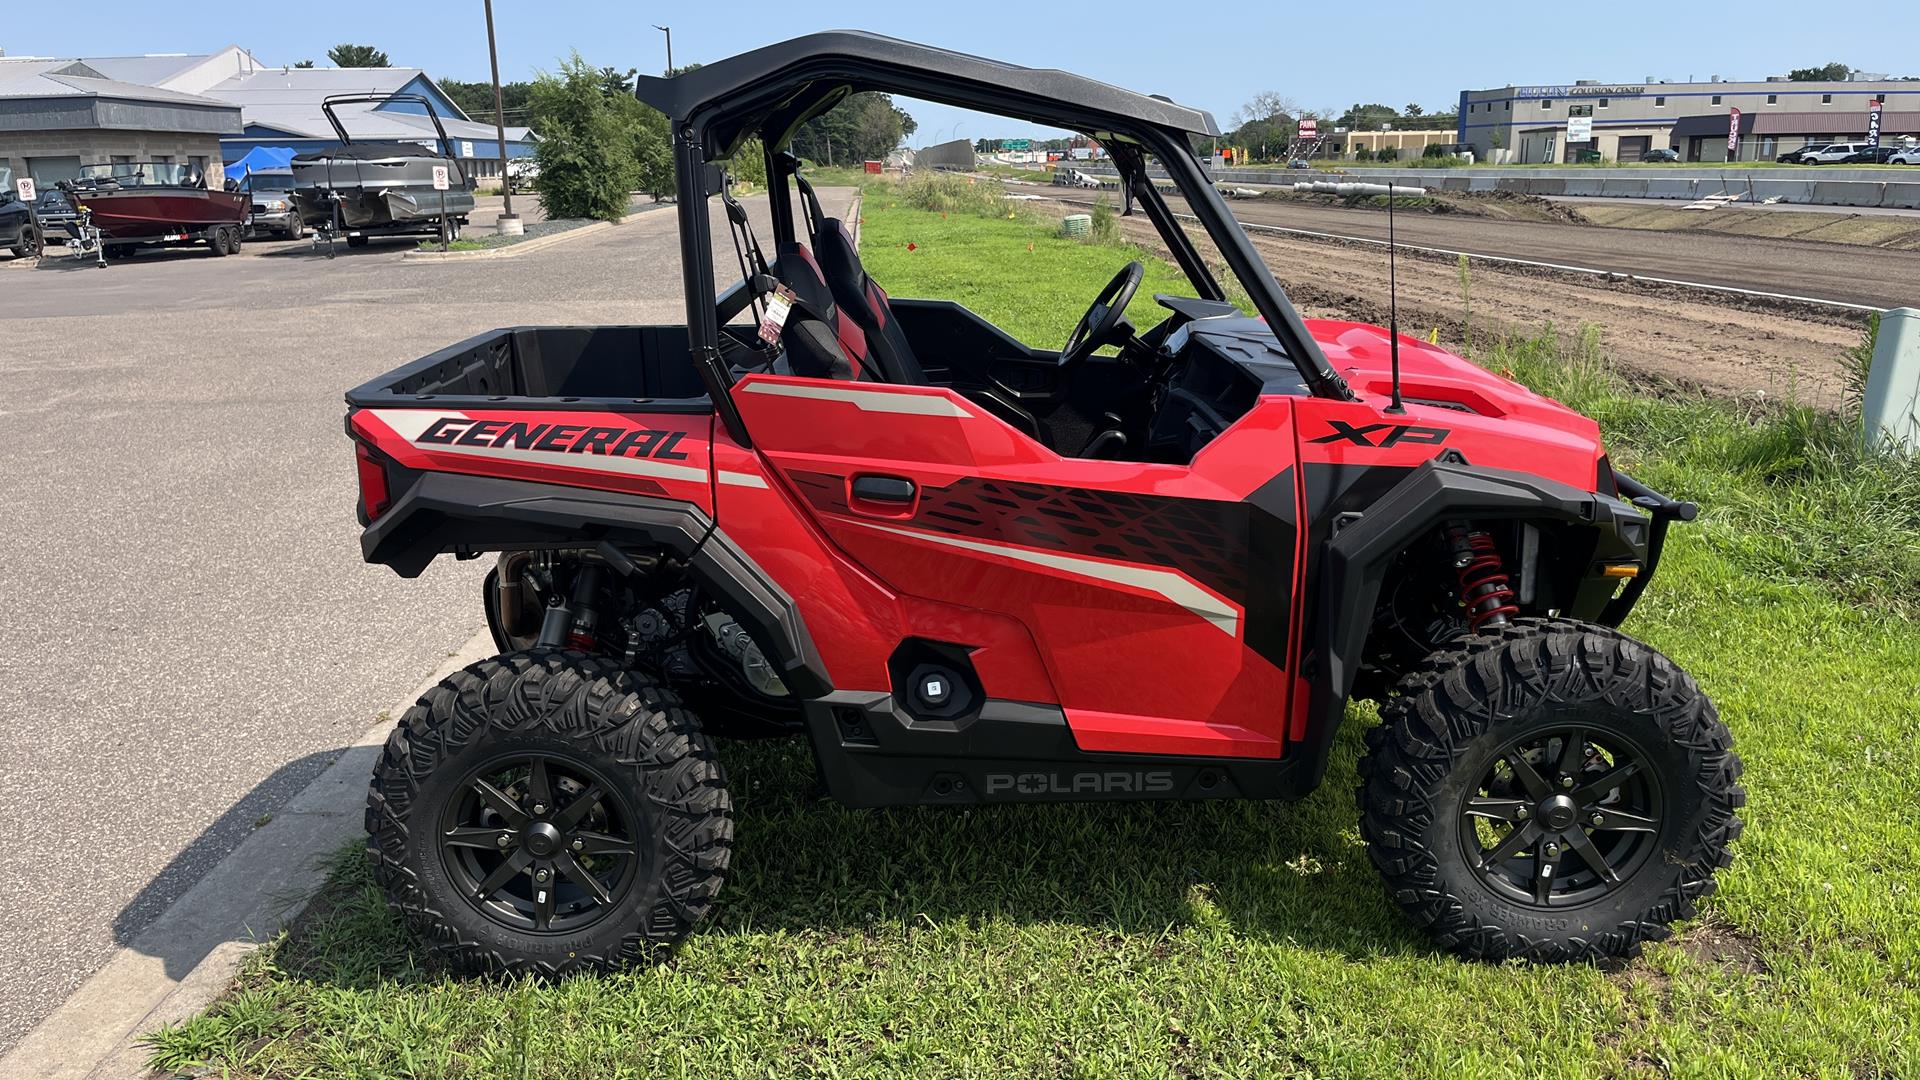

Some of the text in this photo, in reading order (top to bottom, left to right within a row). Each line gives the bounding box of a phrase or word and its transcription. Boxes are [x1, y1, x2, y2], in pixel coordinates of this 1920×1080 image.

[1569, 87, 1615, 96] COLLISION
[1615, 86, 1646, 95] CENTER
[1299, 120, 1317, 129] PAWN
[415, 417, 689, 460] GENERAL
[1304, 420, 1451, 448] XP
[986, 771, 1173, 794] POLARIS
